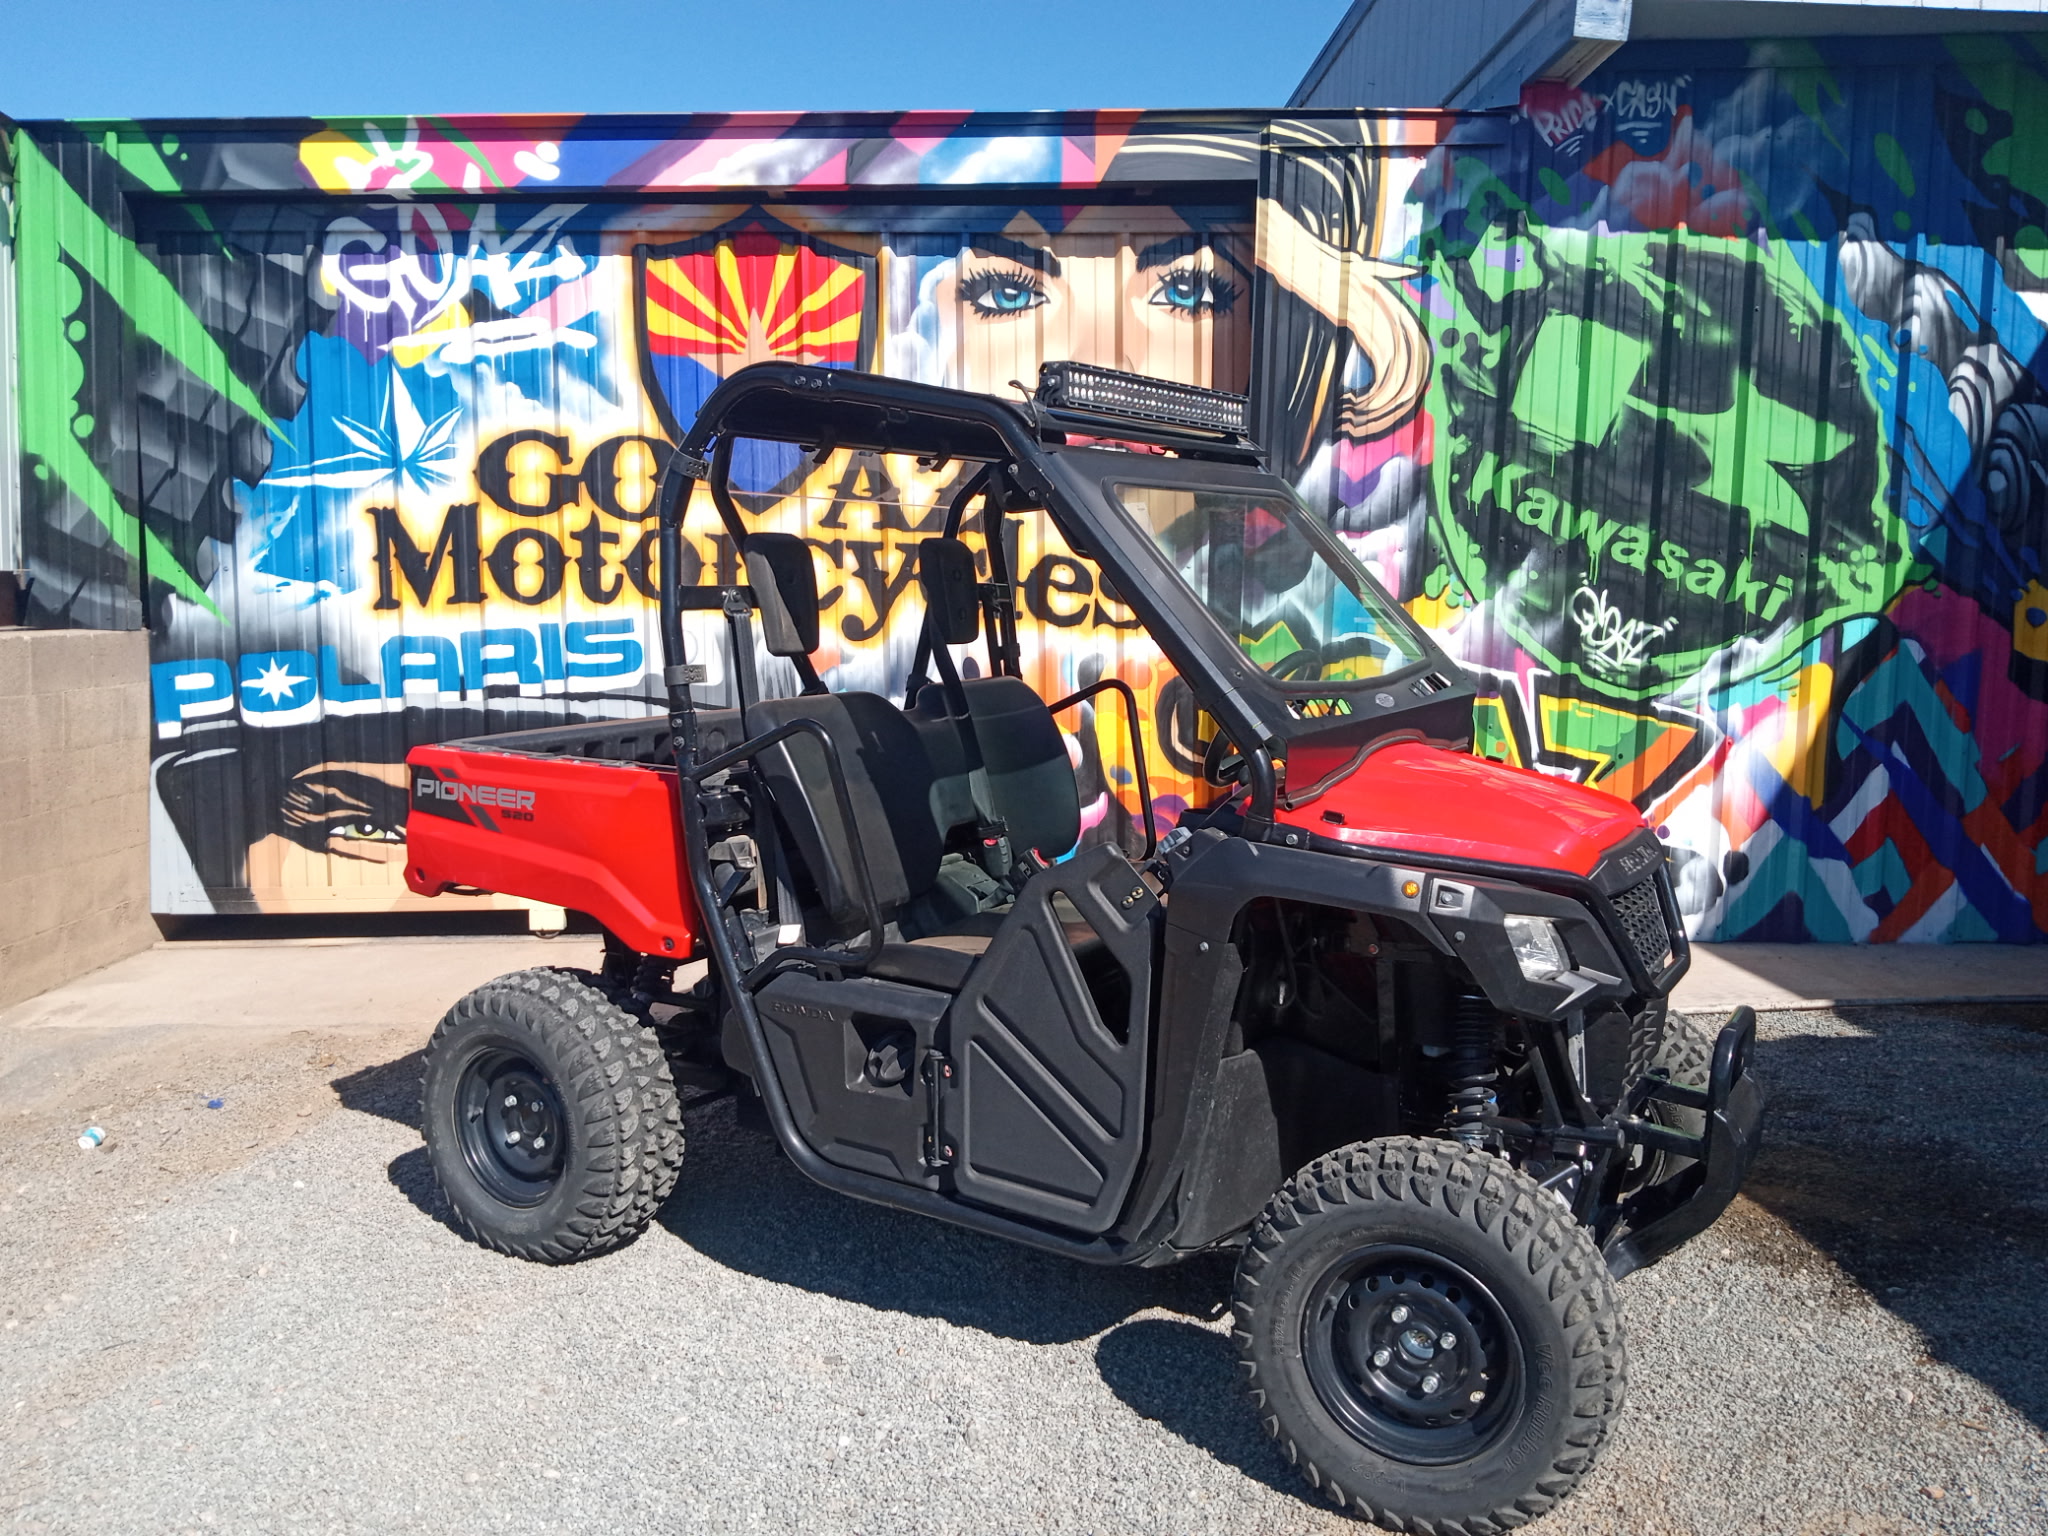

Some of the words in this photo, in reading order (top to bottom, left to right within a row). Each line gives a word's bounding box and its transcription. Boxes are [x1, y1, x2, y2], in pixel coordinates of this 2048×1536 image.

[474, 428, 674, 523] GO
[365, 502, 1142, 642] Motorcyles
[1466, 451, 1795, 622] Kawasaki
[151, 618, 644, 737] POLARIS
[417, 778, 535, 811] PIONEER
[500, 809, 534, 822] 520
[771, 1002, 835, 1022] HONDA
